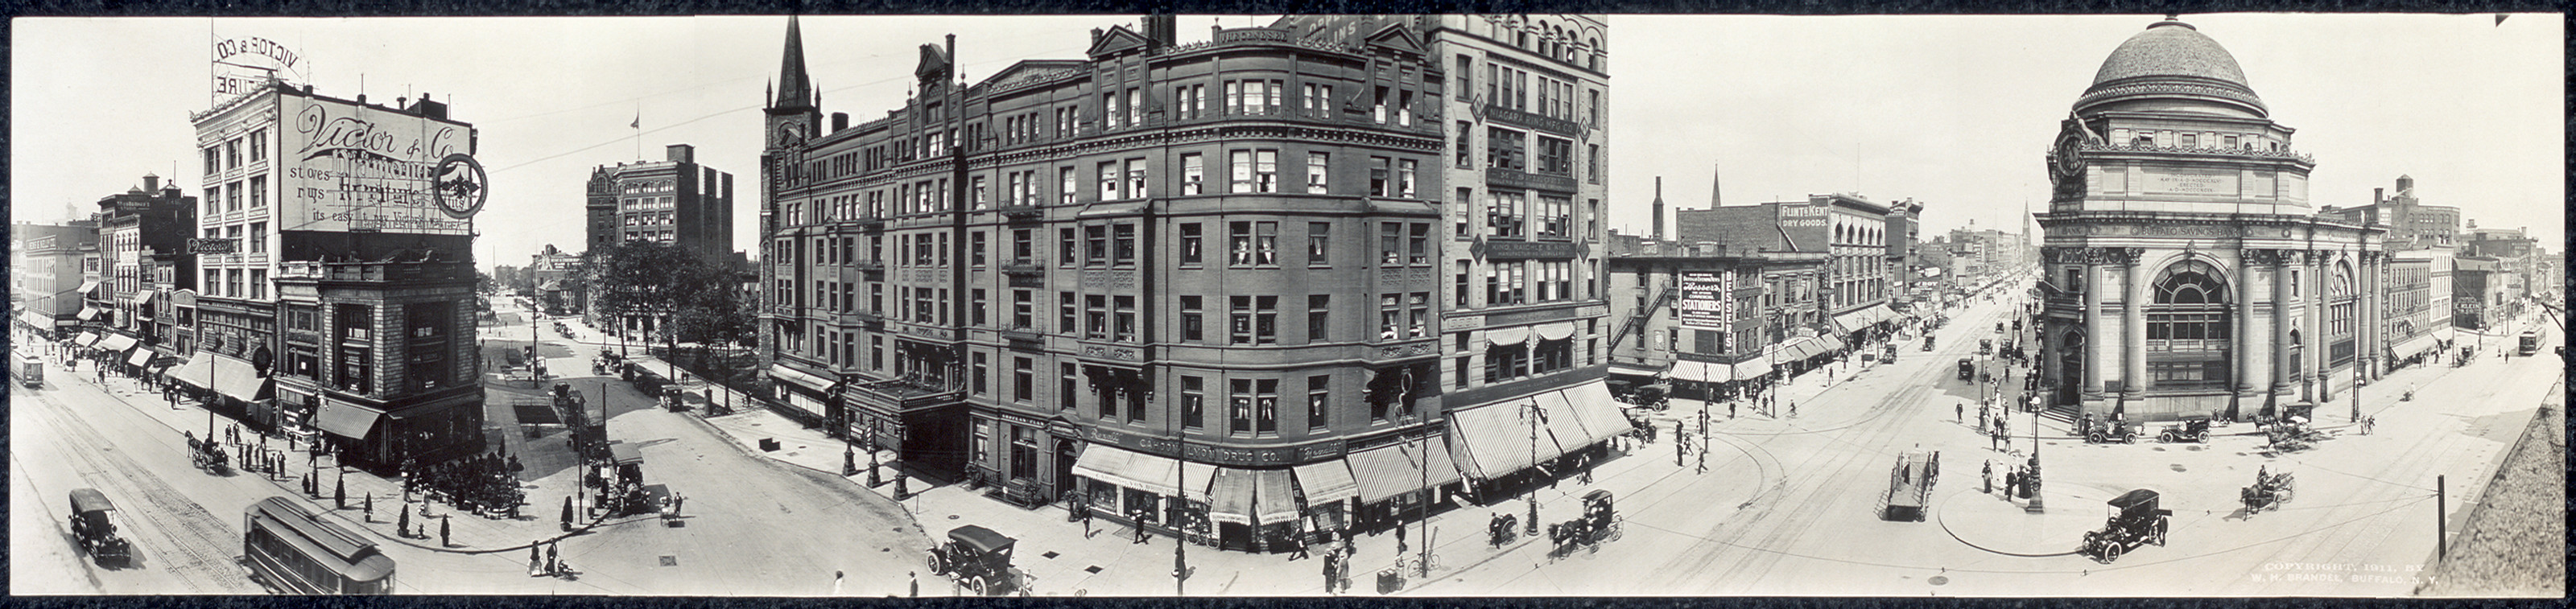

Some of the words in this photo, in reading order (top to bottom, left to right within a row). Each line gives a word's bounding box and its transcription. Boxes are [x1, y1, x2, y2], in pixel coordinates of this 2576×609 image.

[1241, 30, 1287, 41] GENESEE
[1490, 108, 1523, 122] NIAGARA
[1546, 121, 1561, 130] MFG
[296, 104, 397, 154] Victor
[407, 139, 420, 159] &
[290, 165, 330, 181] stoves
[1781, 206, 1803, 216] FLINT
[1809, 205, 1828, 216] KENT
[2142, 226, 2178, 236] BUFFALO
[2180, 226, 2215, 236] SAVINGS
[2218, 228, 2239, 237] BANK
[192, 241, 228, 252] Victor's
[1682, 299, 1721, 312] STATIONERS
[1139, 438, 1180, 454] CAHOON
[1187, 446, 1216, 462] LYON
[1223, 451, 1253, 462] DRUG
[1261, 452, 1280, 462] CO.
